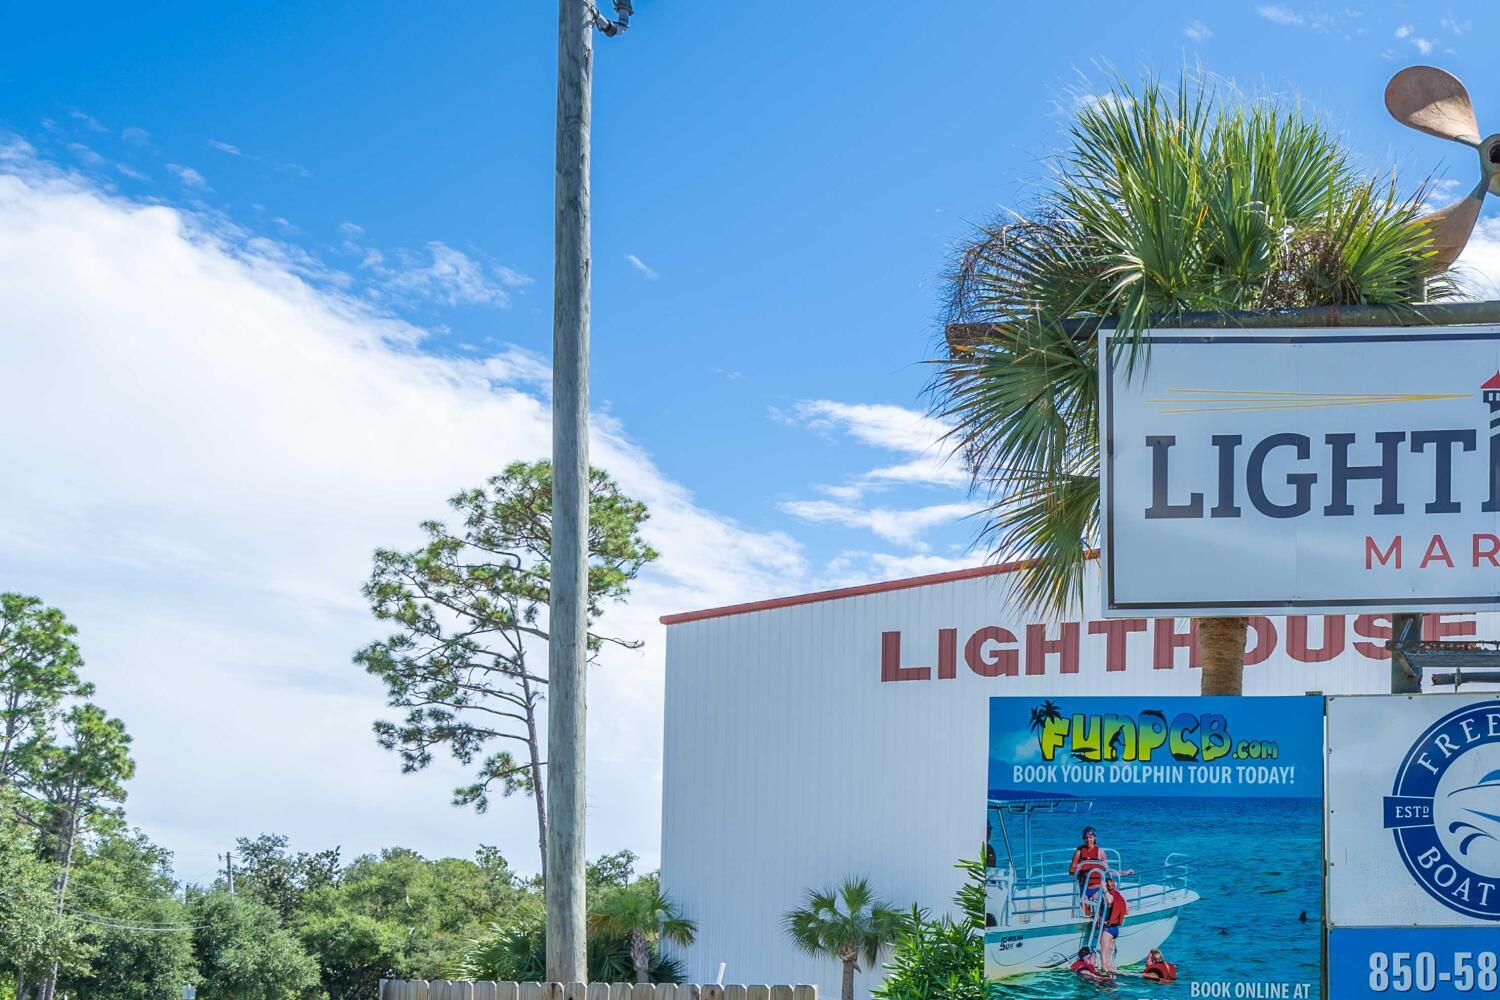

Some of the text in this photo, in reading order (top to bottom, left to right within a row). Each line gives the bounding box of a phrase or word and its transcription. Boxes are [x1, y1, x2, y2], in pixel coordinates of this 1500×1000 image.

[1013, 765, 1295, 785] BOOK YOUR DOLPHIN TOUR TODAY!
[1417, 846, 1495, 906] BOAT
[1190, 981, 1311, 1000] BOOK ONLINE AT
